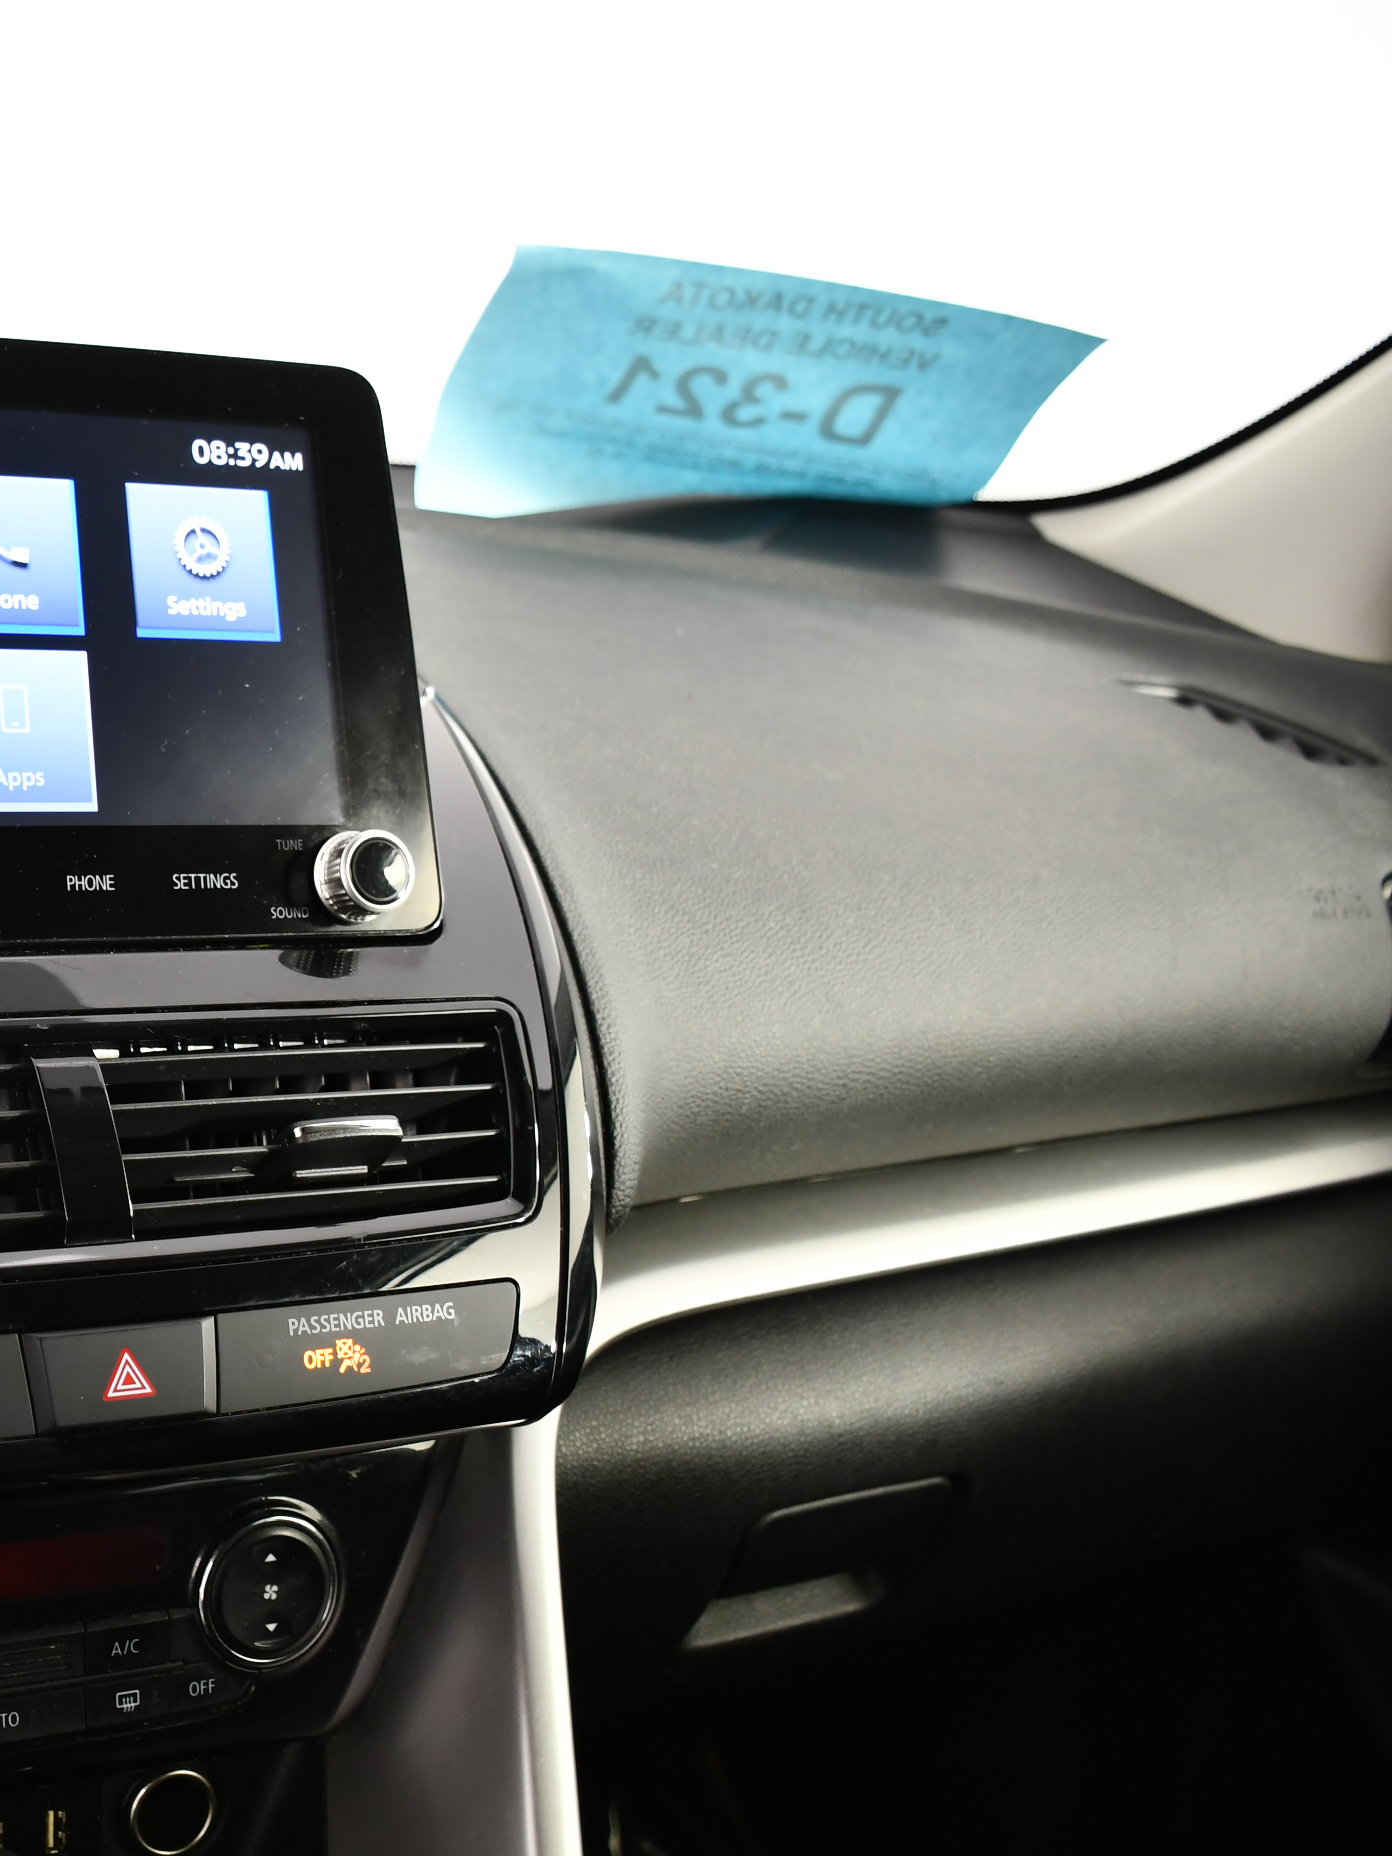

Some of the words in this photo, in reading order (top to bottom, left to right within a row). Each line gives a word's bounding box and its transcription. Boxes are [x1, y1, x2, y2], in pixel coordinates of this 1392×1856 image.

[166, 595, 247, 622] Settings
[275, 839, 304, 851] TUNE
[66, 874, 116, 892] PHONE
[172, 872, 239, 891] SETTINGS
[270, 907, 309, 920] SOUND
[288, 1309, 385, 1336] PASSENGER
[395, 1301, 455, 1325] AIRBAG
[303, 1347, 334, 1369] OFF
[111, 1638, 140, 1657] A/C
[188, 1678, 216, 1697] OFF
